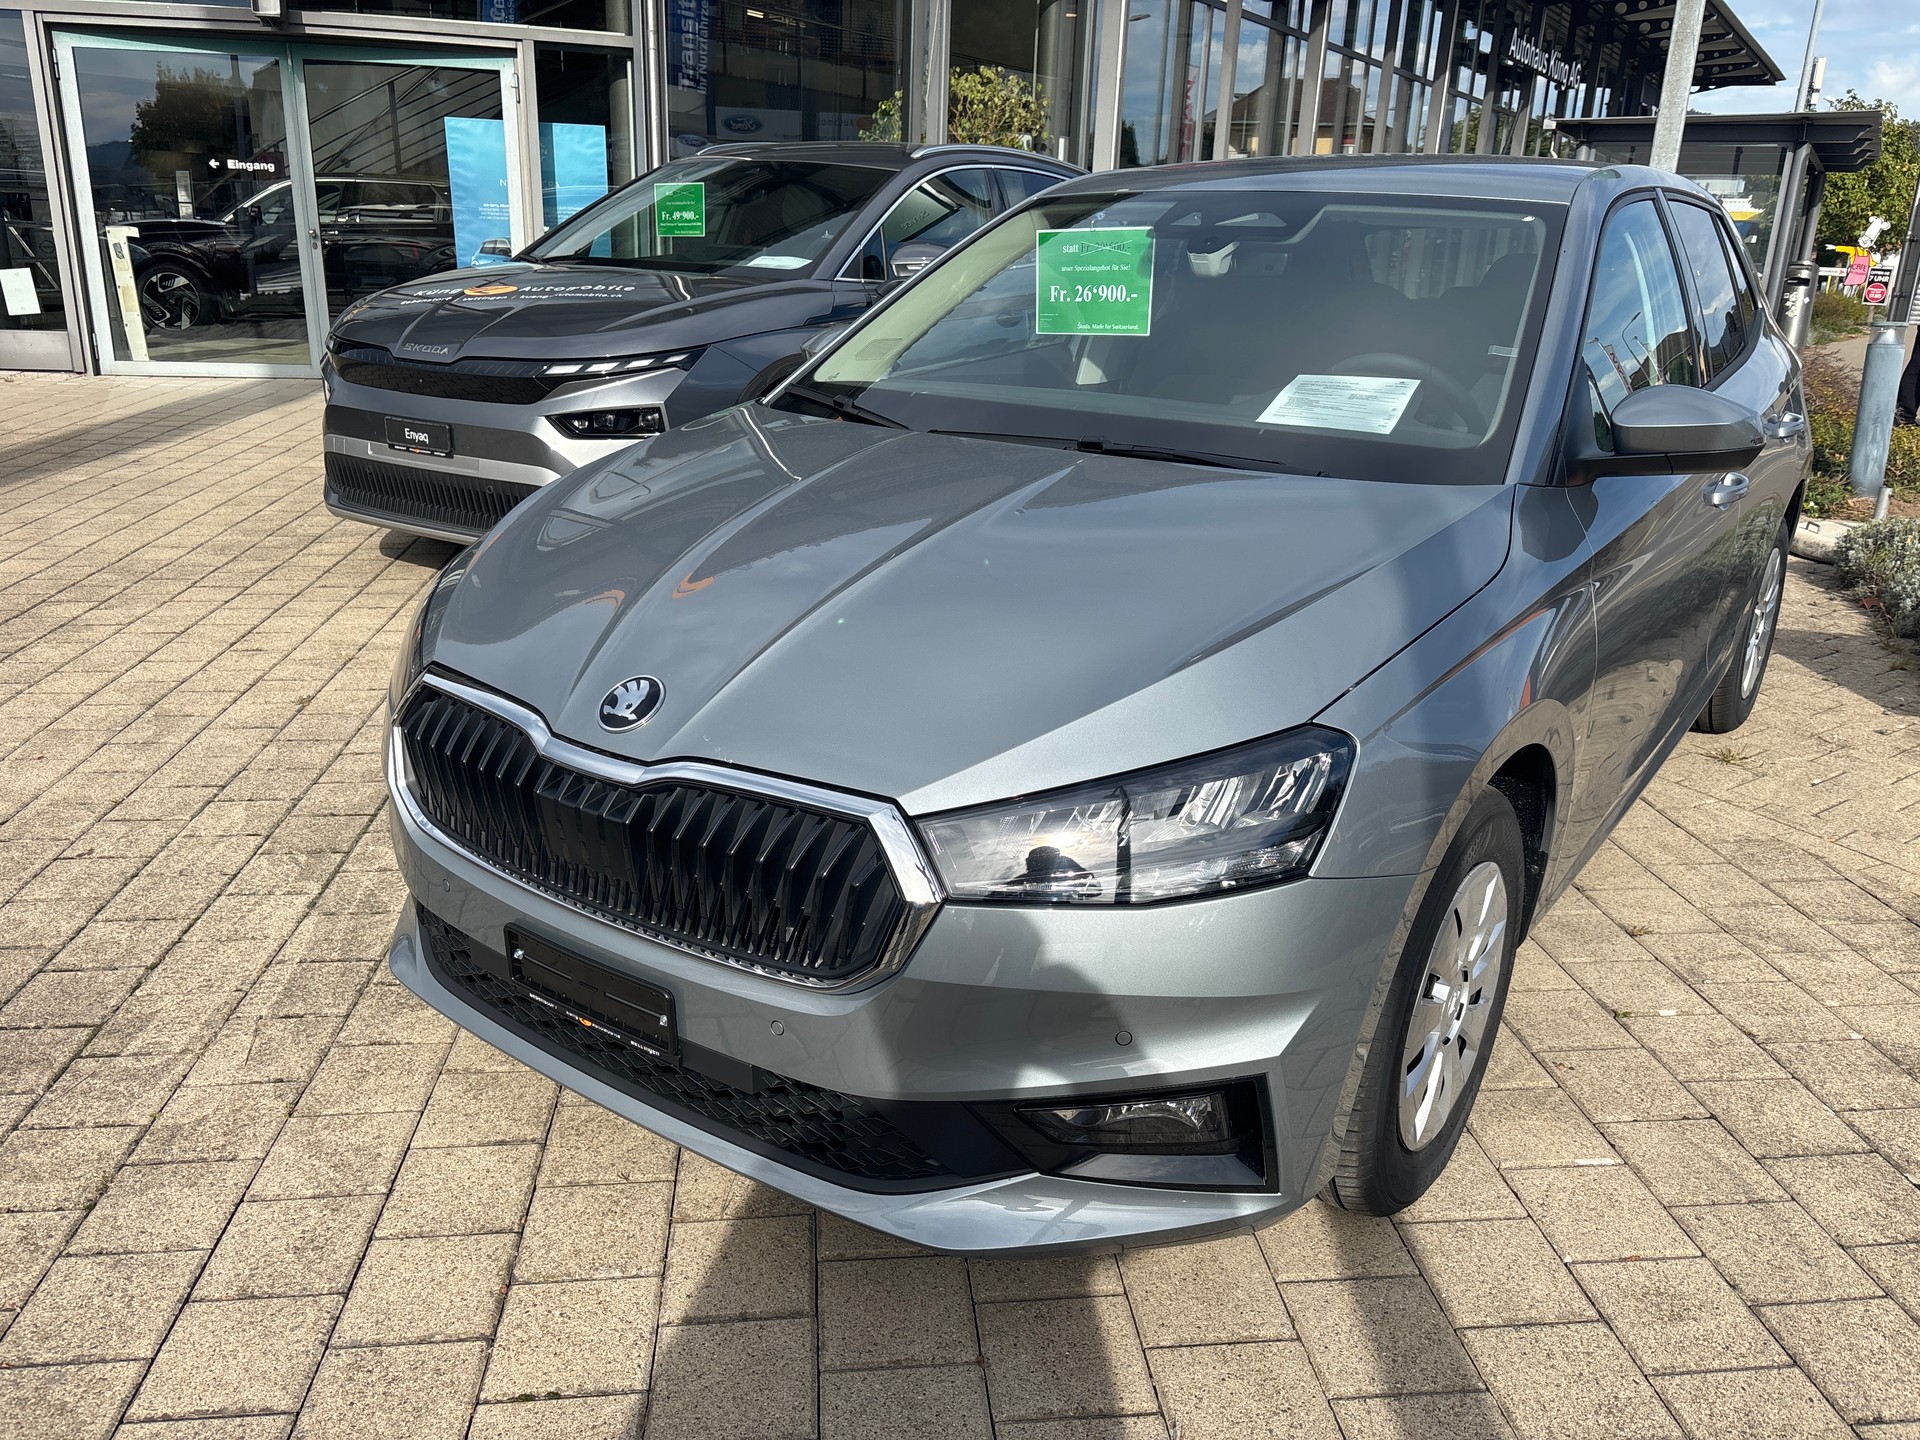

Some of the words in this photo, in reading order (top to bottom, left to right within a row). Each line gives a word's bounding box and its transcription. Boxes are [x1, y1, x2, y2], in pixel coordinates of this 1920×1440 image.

[677, 0, 696, 91] Transit
[1508, 27, 1549, 74] Autohaus
[1548, 49, 1569, 91] Küng
[1568, 61, 1582, 89] AG
[226, 159, 275, 173] Eingang
[661, 211, 672, 221] Fr.
[1062, 243, 1079, 254] statt
[1074, 264, 1111, 273] Spezialangebot
[1049, 285, 1071, 302] Fr.
[1074, 284, 1138, 303] 26'900.-
[404, 427, 429, 445] Enyaq
